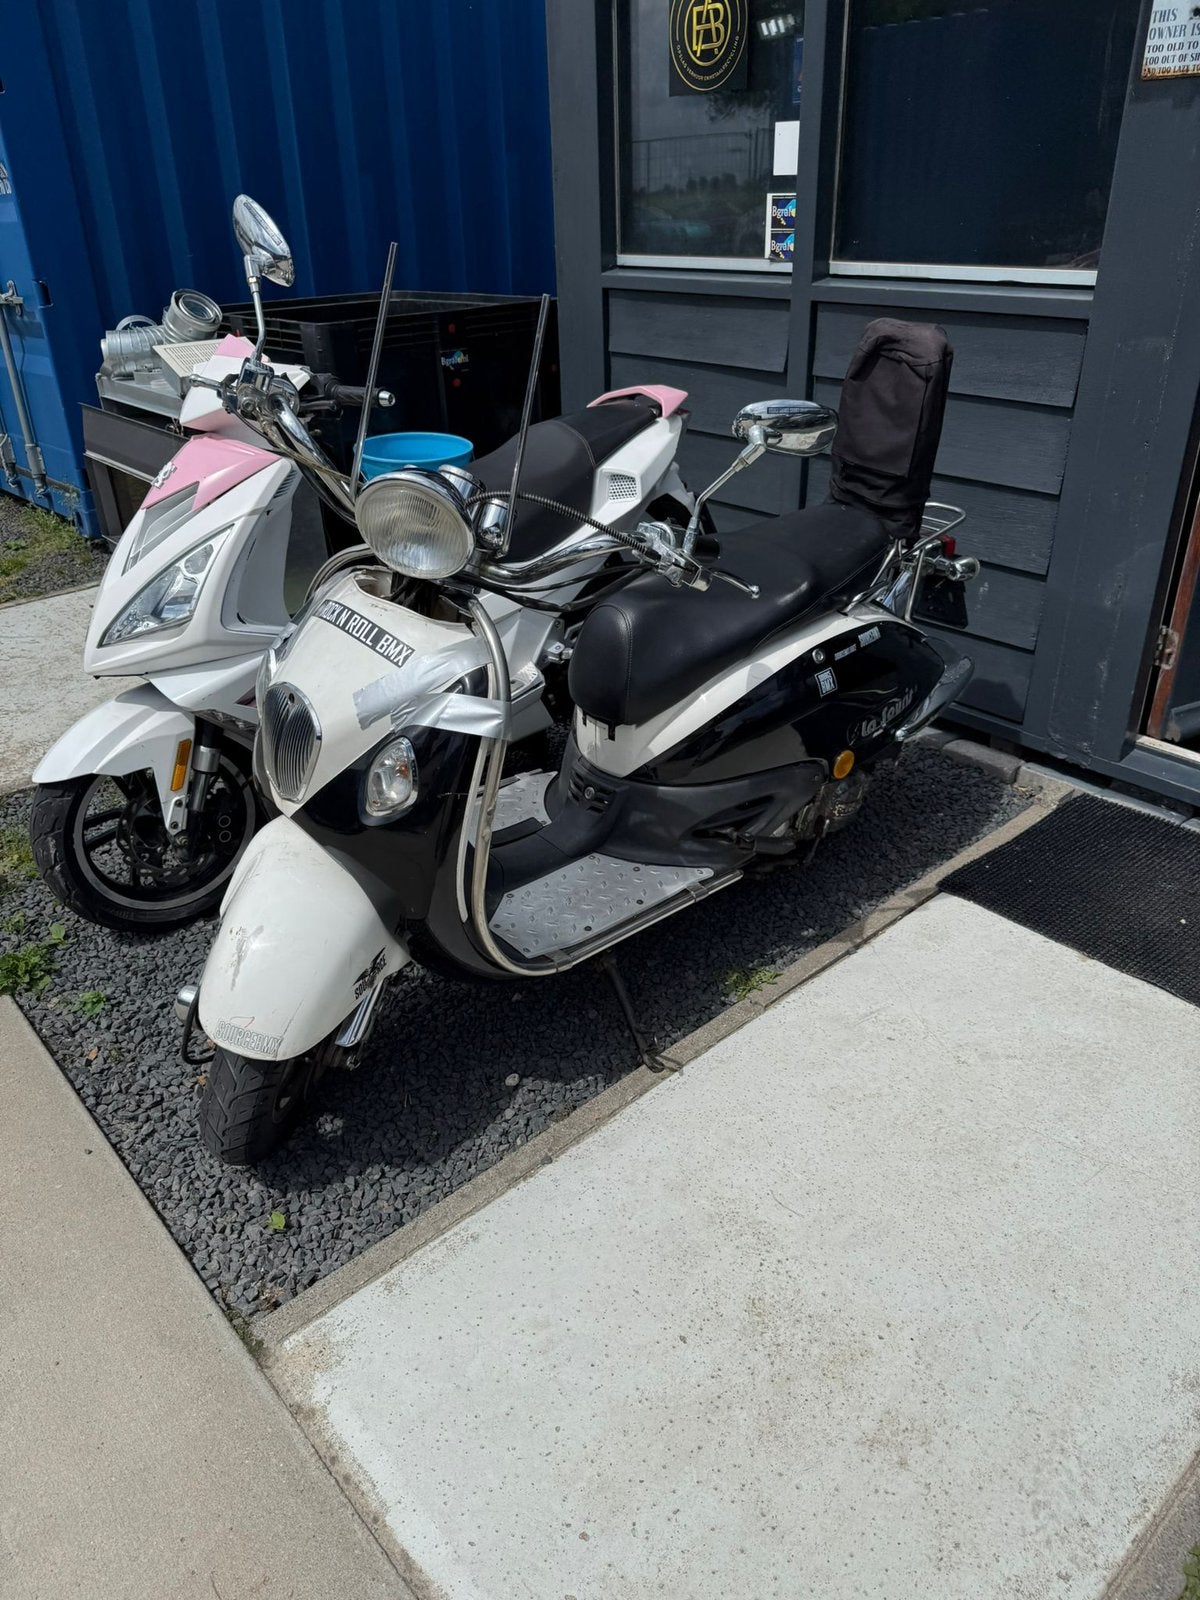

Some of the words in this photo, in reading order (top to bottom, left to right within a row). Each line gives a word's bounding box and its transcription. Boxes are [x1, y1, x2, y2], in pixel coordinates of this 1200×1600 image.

[1152, 8, 1178, 23] THIS
[1149, 25, 1187, 40] OWNER
[1147, 44, 1164, 54] TOO
[1167, 41, 1184, 52] OLD
[1188, 40, 1199, 50] TO
[1145, 56, 1159, 66] TOO
[1161, 54, 1176, 64] OUT
[1178, 53, 1187, 63] OF
[336, 608, 352, 627] N
[344, 613, 379, 646] ROLL
[375, 633, 412, 667] BMX
[216, 1021, 283, 1056] SOURCEBMX
